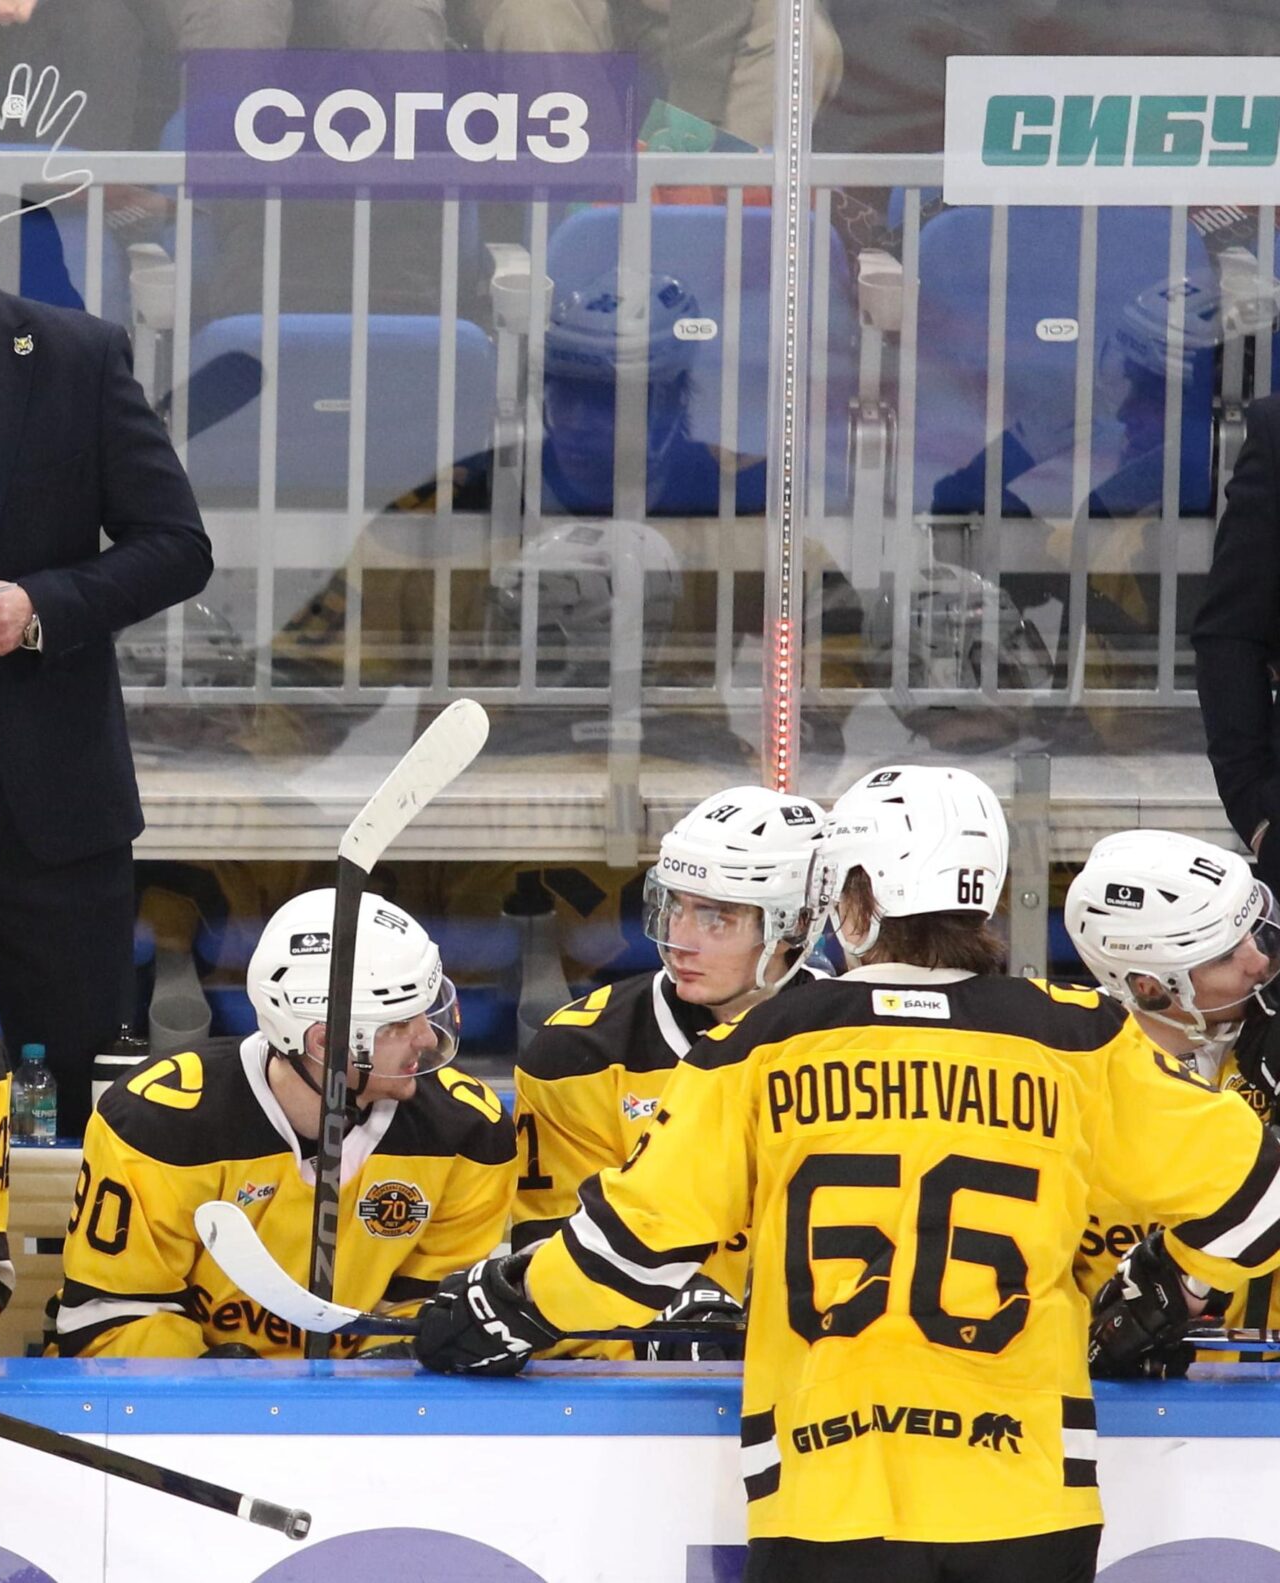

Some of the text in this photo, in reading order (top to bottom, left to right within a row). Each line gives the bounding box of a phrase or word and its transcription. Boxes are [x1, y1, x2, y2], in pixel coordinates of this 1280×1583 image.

[678, 323, 715, 336] 106
[1041, 324, 1076, 336] 107
[1188, 857, 1227, 886] 10
[957, 868, 984, 905] 66
[373, 909, 409, 935] 90
[903, 1000, 942, 1010] БАНК
[767, 1060, 1059, 1139] PODSHIVALOV
[381, 1200, 406, 1220] 70
[785, 1153, 1040, 1354] 66
[792, 1404, 962, 1454] GISLAVED
